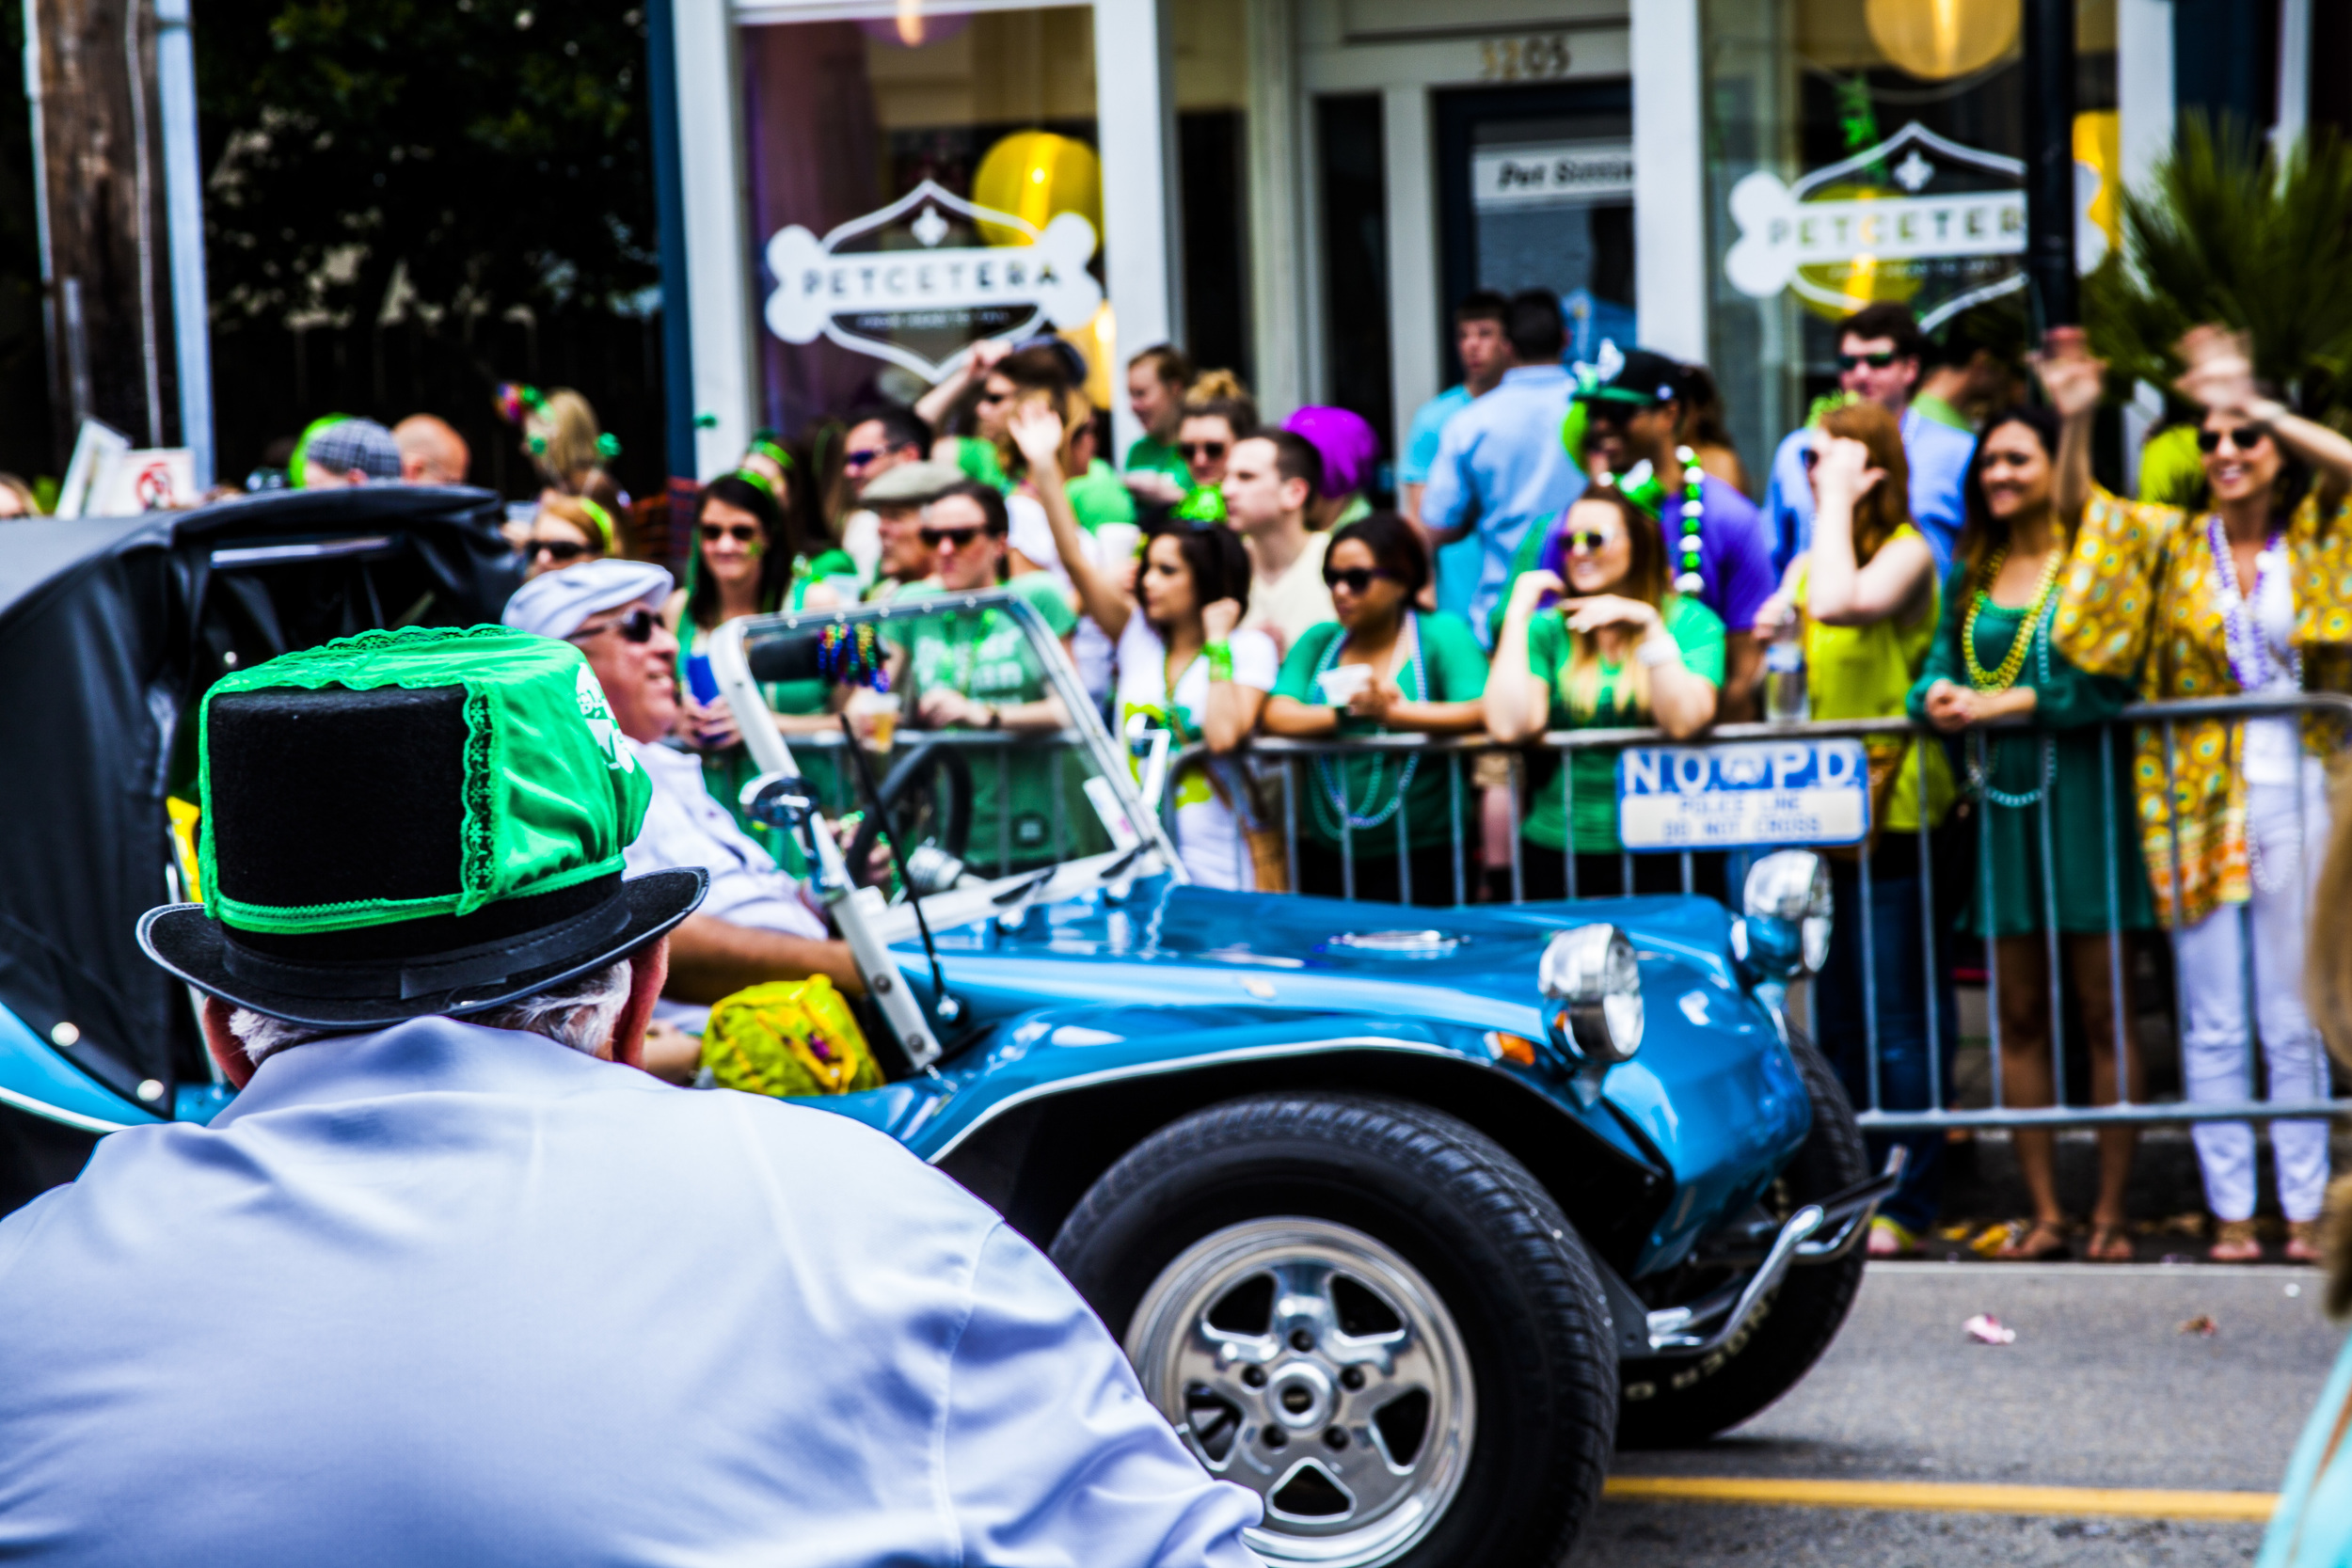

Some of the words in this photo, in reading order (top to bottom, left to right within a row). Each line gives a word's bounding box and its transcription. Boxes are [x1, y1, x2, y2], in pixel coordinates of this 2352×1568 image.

[1498, 160, 1547, 190] Pet
[1766, 208, 2026, 248] PETCETER
[800, 258, 1061, 300] PETCETERA
[1679, 796, 1745, 814] POLICE
[1762, 794, 1801, 810] LINE
[1663, 820, 1689, 836] DO
[1703, 818, 1740, 834] NOT
[1756, 816, 1821, 833] CROSS
